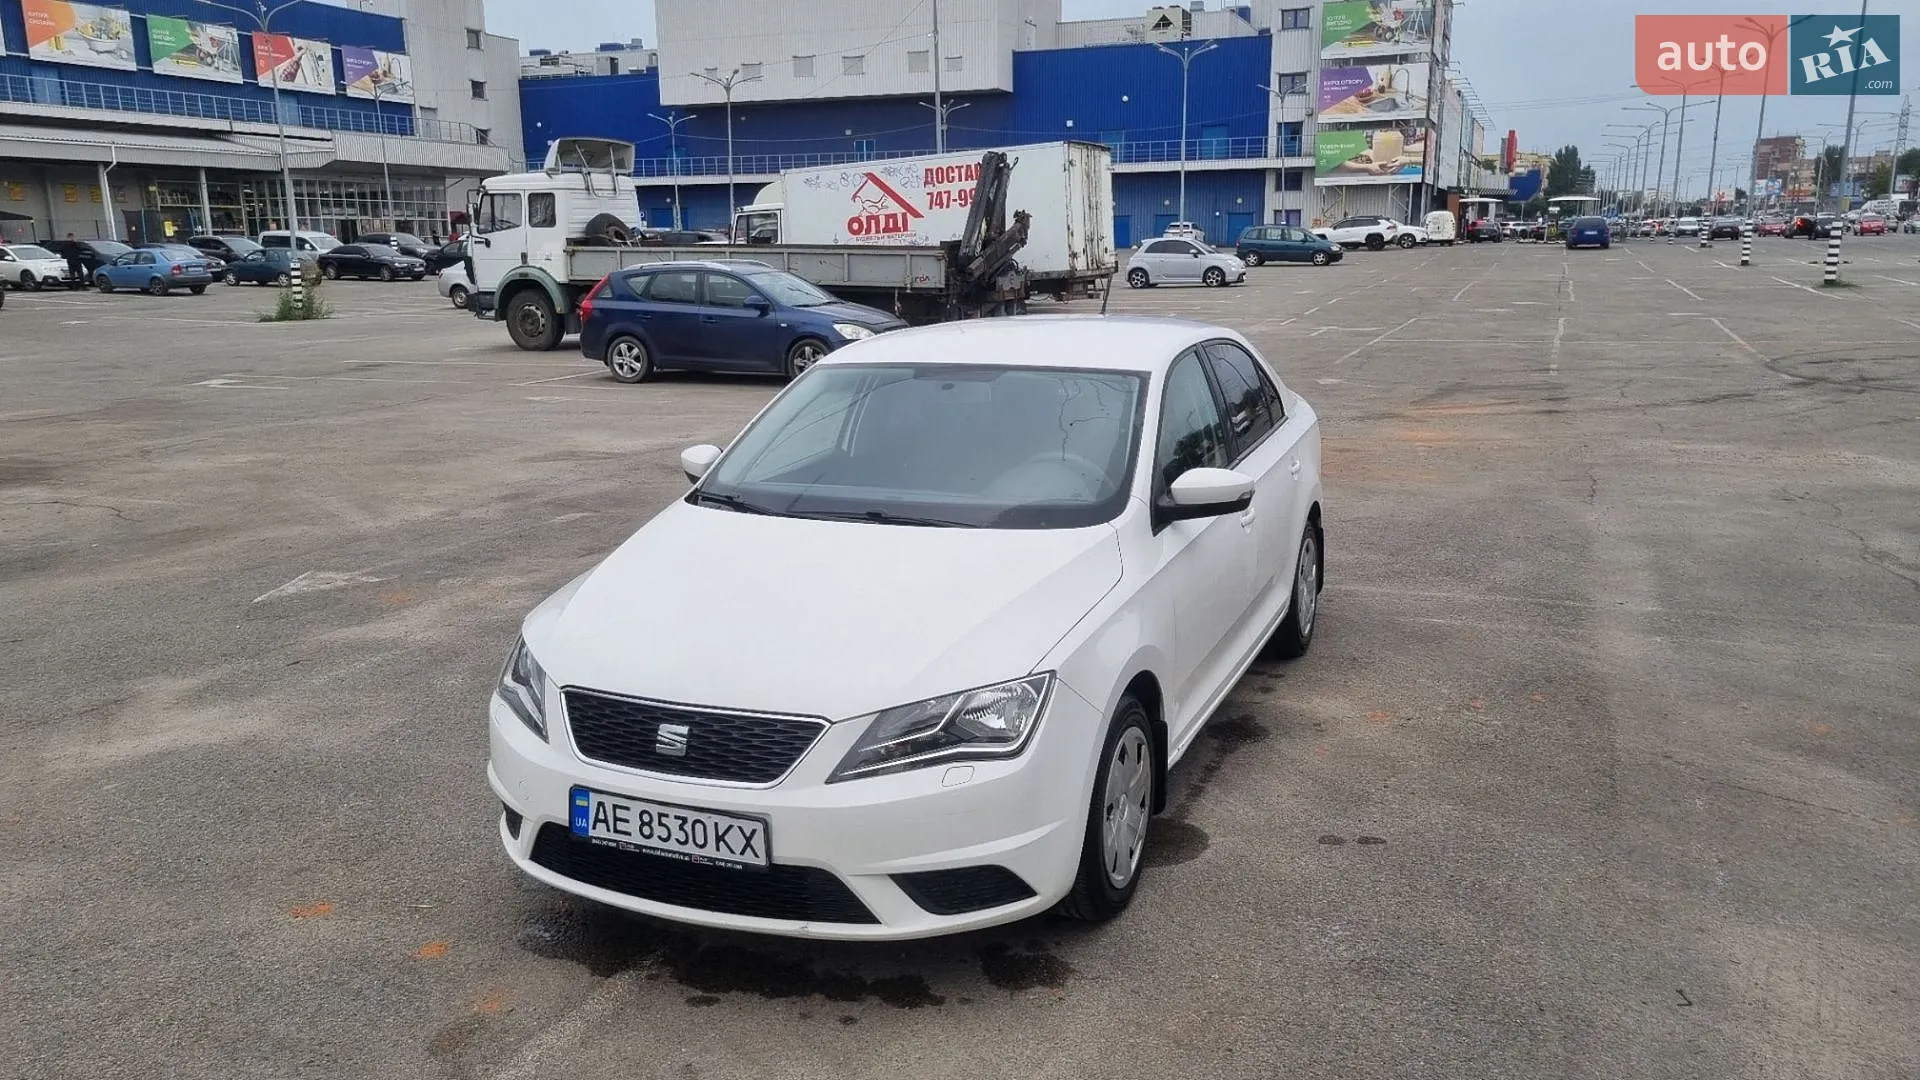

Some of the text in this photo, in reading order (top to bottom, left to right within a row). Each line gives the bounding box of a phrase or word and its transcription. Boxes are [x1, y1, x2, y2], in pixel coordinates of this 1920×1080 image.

[847, 212, 909, 236] ОЛДІ
[575, 816, 588, 828] UA
[592, 800, 760, 858] AE 8530 KX
